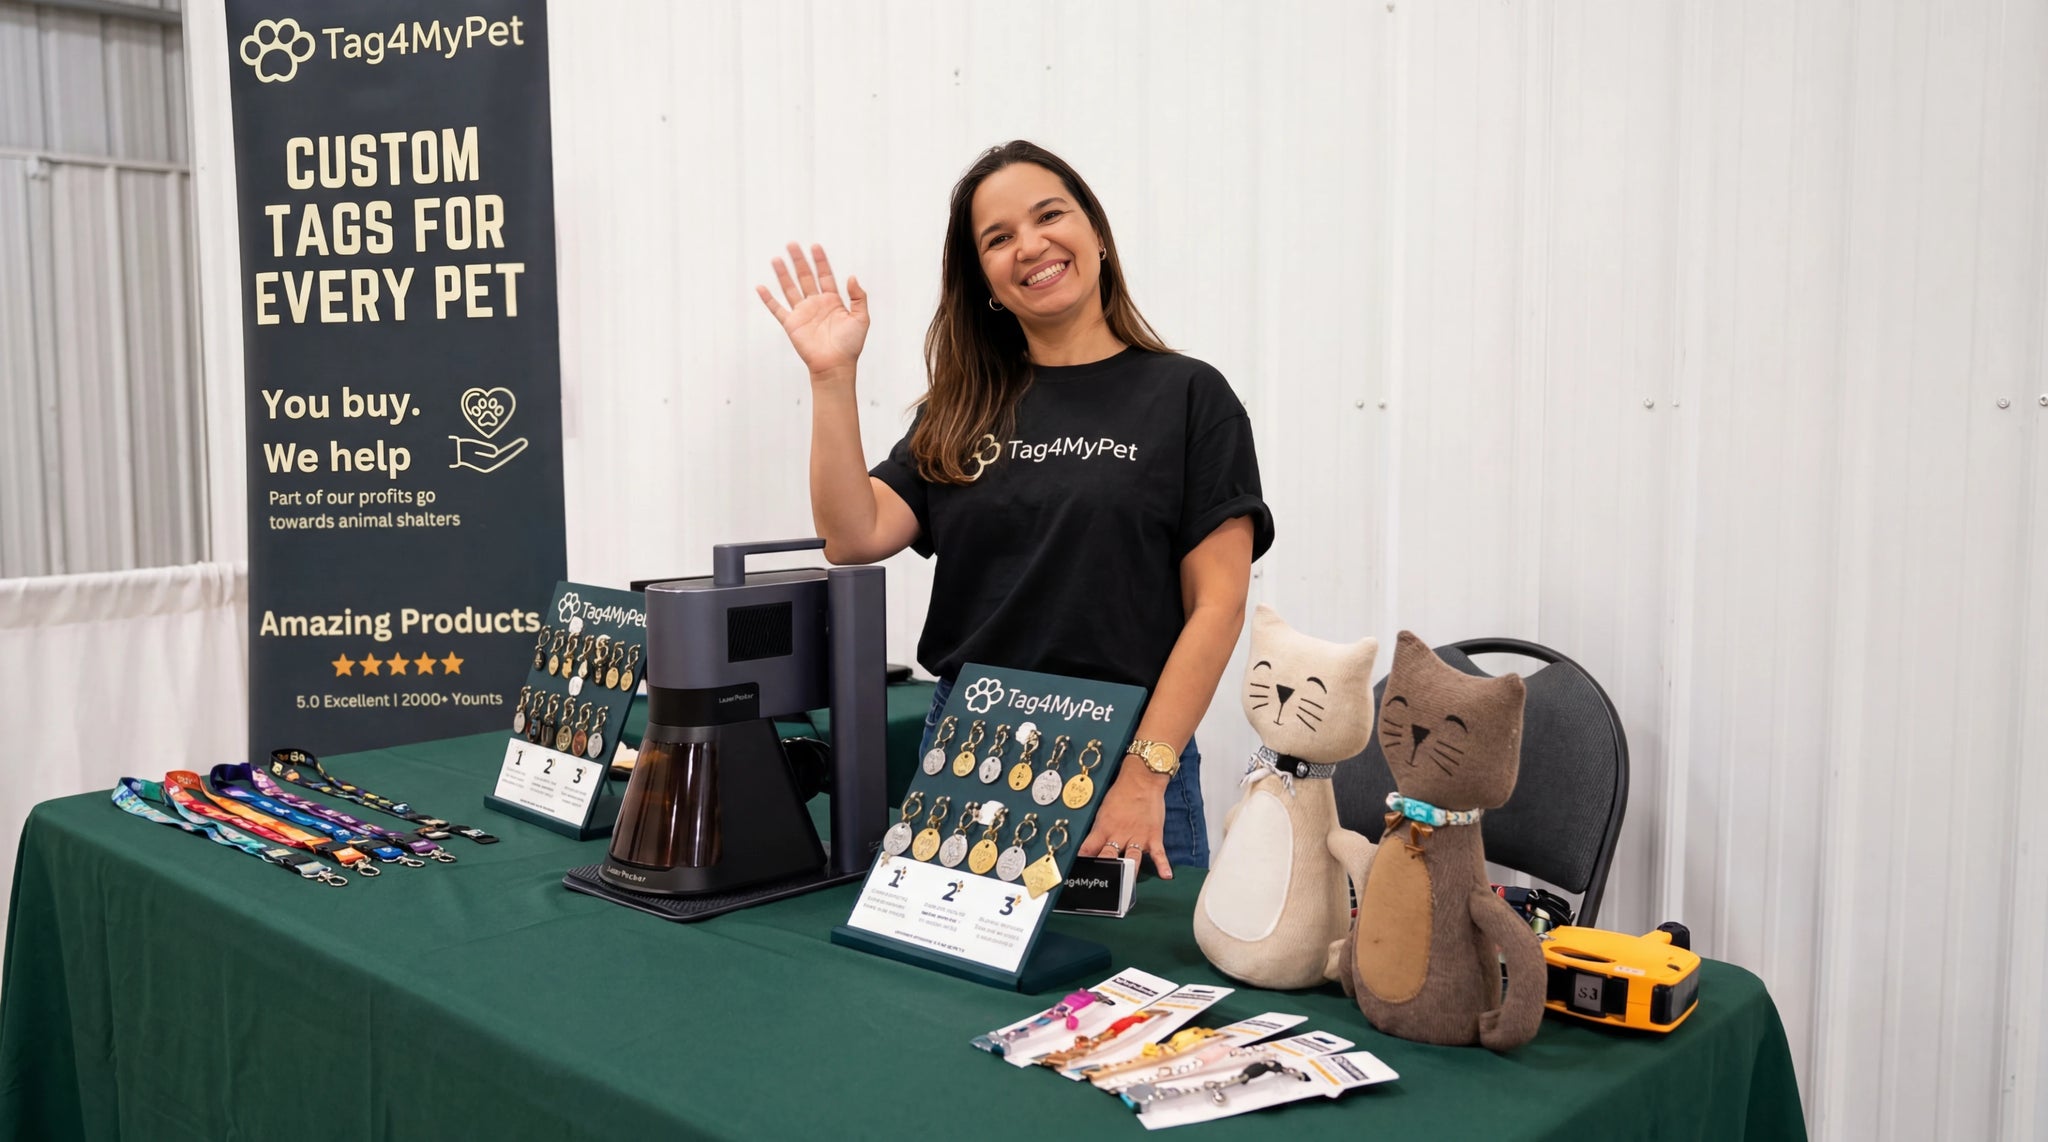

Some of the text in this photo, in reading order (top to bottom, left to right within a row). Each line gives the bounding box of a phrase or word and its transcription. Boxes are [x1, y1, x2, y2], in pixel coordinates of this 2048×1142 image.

[321, 15, 525, 65] Tag4MyPet
[286, 126, 480, 190] CUSTOM
[264, 194, 505, 258] TAGS FOR
[255, 262, 526, 326] EVERY PET
[261, 386, 421, 426] You buy.
[263, 439, 411, 480] We help
[1008, 436, 1139, 463] Tag4MyPet
[269, 487, 436, 508] Part of our profits go
[269, 510, 461, 530] towards animal shalters
[259, 606, 541, 642] Amazing Products
[296, 694, 320, 709] 5.0
[323, 693, 391, 709] Excellent
[401, 692, 449, 707] 2000+
[451, 691, 504, 706] Younts
[1007, 688, 1114, 722] Tag4MyPet
[515, 750, 523, 766] 1
[543, 758, 553, 775] 2
[572, 767, 584, 784] 3
[888, 869, 902, 888] 1
[941, 881, 959, 902] 2
[998, 895, 1016, 916] 3
